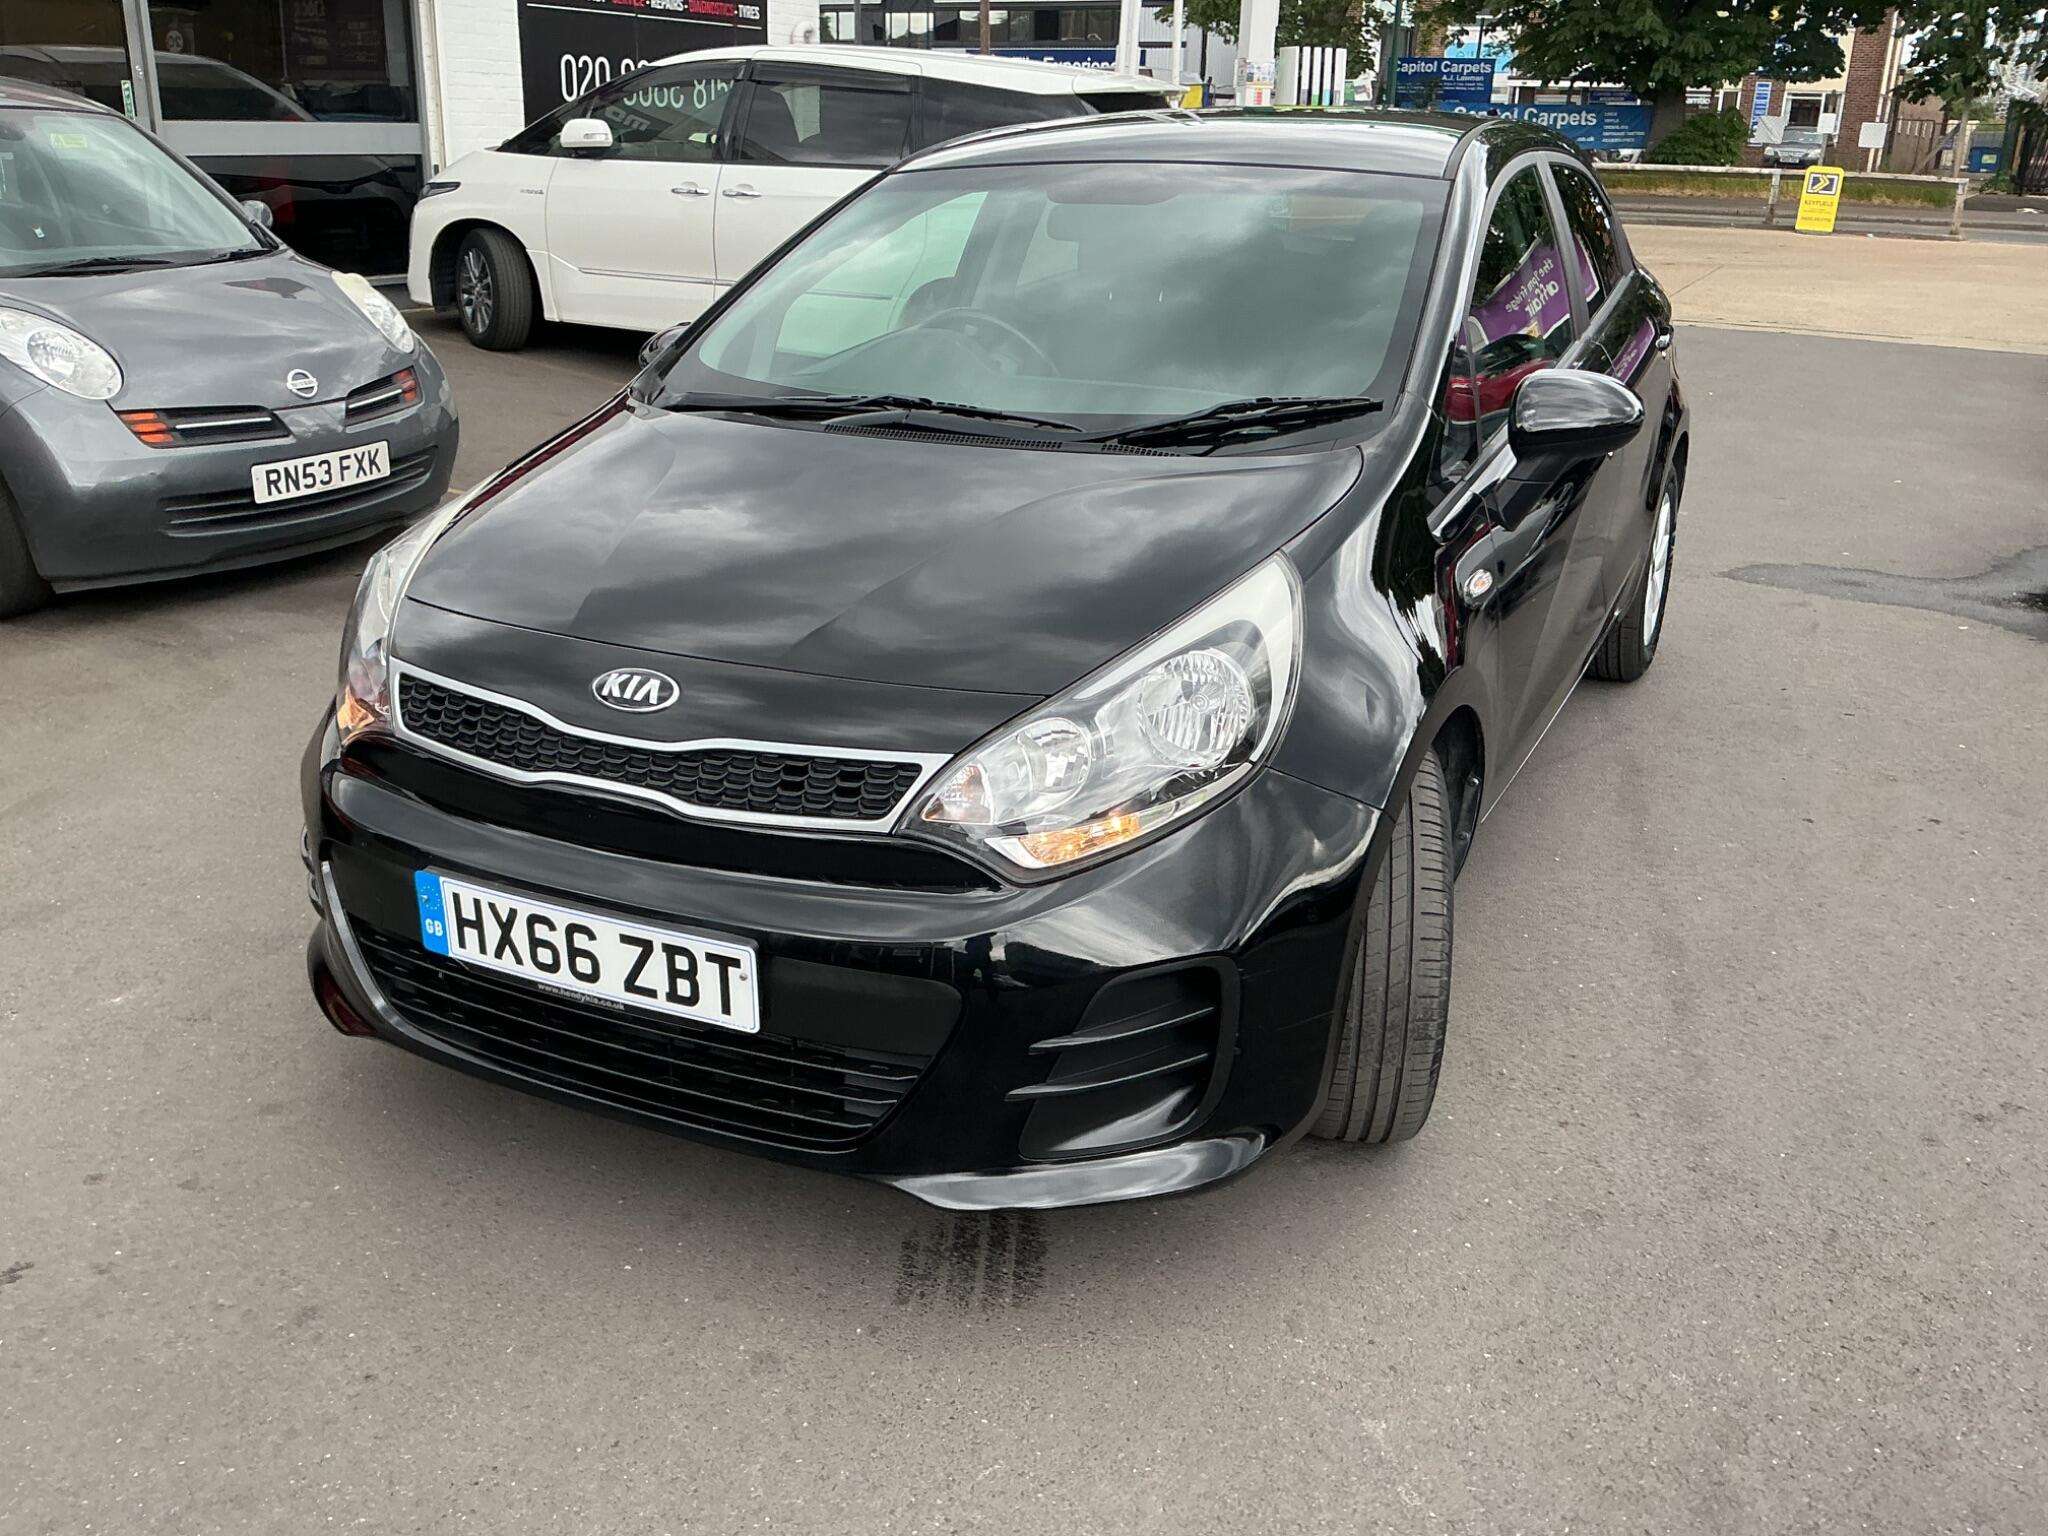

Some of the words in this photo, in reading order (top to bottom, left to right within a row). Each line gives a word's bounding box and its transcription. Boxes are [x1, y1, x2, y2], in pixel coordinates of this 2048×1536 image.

[738, 4, 760, 20] TYRES
[1441, 61, 1492, 75] Carpets
[1524, 107, 1597, 129] Carpets
[265, 459, 333, 496] RN53
[339, 448, 381, 482] FXK
[601, 672, 661, 705] KIA
[424, 917, 444, 937] GB
[451, 891, 601, 985] HX66
[618, 933, 742, 1017] ZBT
